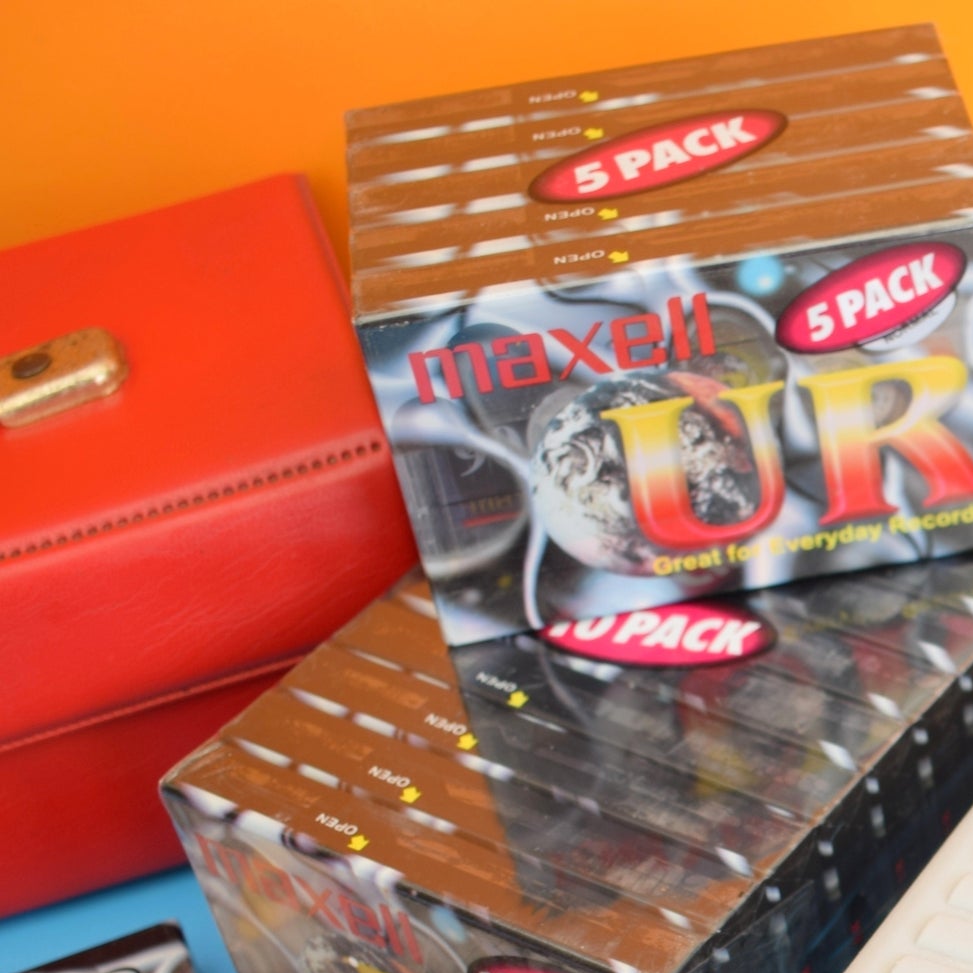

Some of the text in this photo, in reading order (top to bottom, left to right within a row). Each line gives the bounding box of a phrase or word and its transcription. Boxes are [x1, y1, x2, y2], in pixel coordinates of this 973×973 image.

[528, 89, 577, 104] OPEN
[532, 126, 581, 142] OPEN
[574, 116, 757, 194] 5 PACK
[544, 206, 595, 222] OPEN
[553, 249, 605, 265] OPEN
[806, 302, 835, 343] 5
[835, 253, 944, 329] PACK
[408, 292, 717, 405] maxell
[653, 548, 722, 576] Great
[726, 541, 762, 565] for
[769, 522, 882, 557] Everyday
[612, 612, 761, 656] PACK
[475, 671, 518, 693] OPEN
[424, 713, 467, 736] OPEN
[368, 765, 411, 788] OPEN
[315, 812, 358, 836] OPEN
[196, 833, 423, 965] maxell
